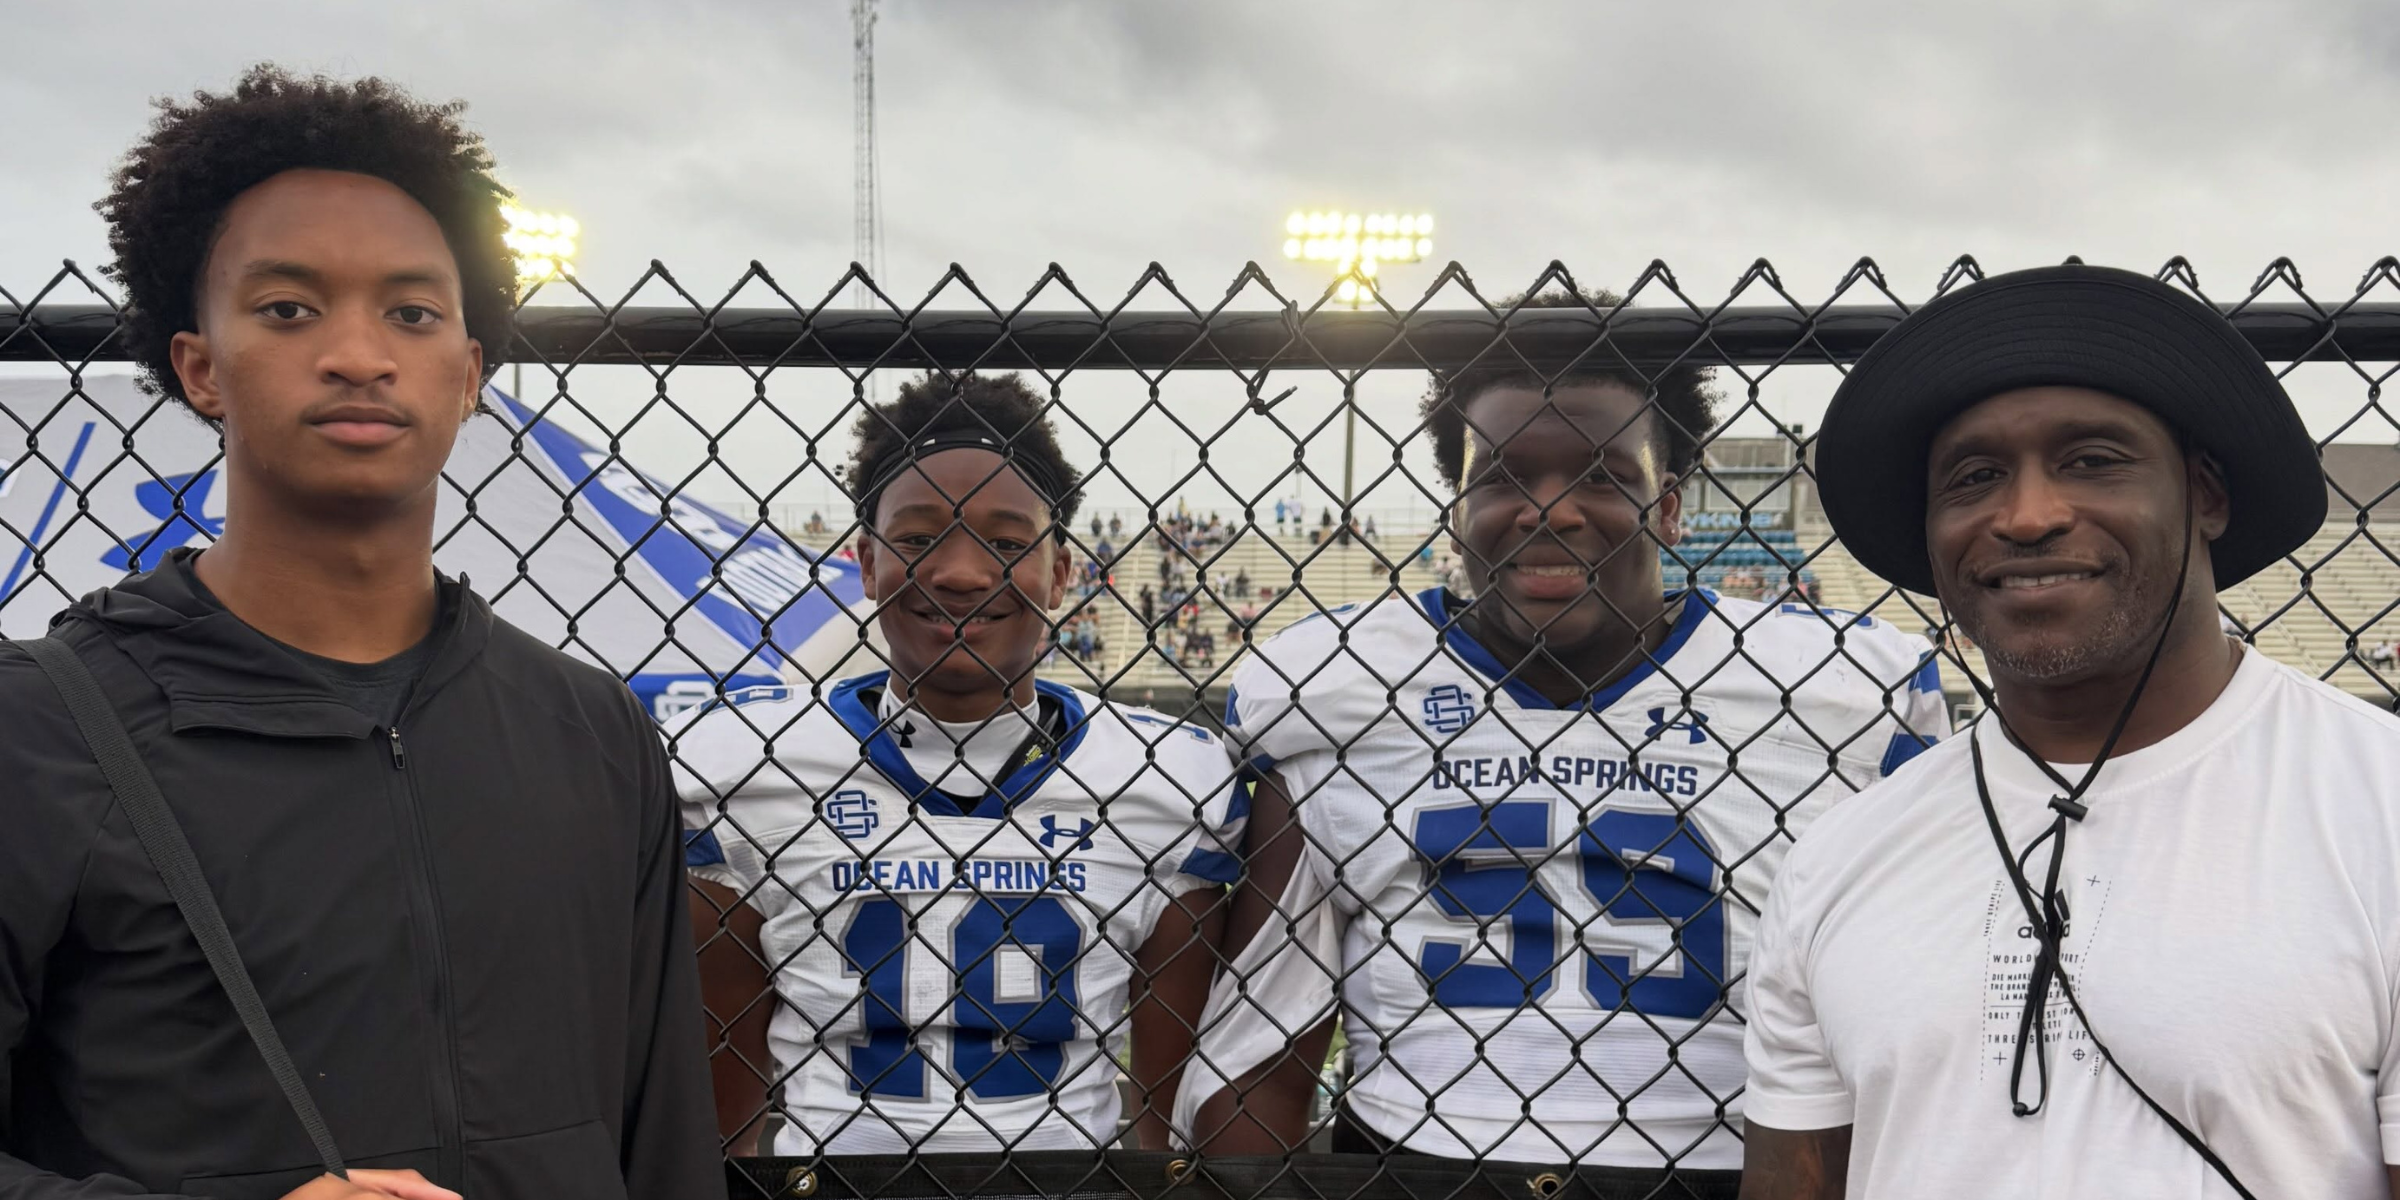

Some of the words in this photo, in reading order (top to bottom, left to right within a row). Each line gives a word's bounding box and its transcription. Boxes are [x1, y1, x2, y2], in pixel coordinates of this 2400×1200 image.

[1432, 755, 1540, 790] OCEAN
[1552, 755, 1699, 796] SPRINGS
[832, 860, 940, 892] OCEAN
[953, 860, 1087, 892] SPRINGS
[1409, 798, 1731, 1020] 59
[1993, 953, 2032, 964] WORLD
[838, 894, 1087, 1105] 18
[1988, 1011, 2010, 1020] ONLY
[1988, 1034, 2017, 1044] THRE
[2068, 1030, 2093, 1041] LIF
